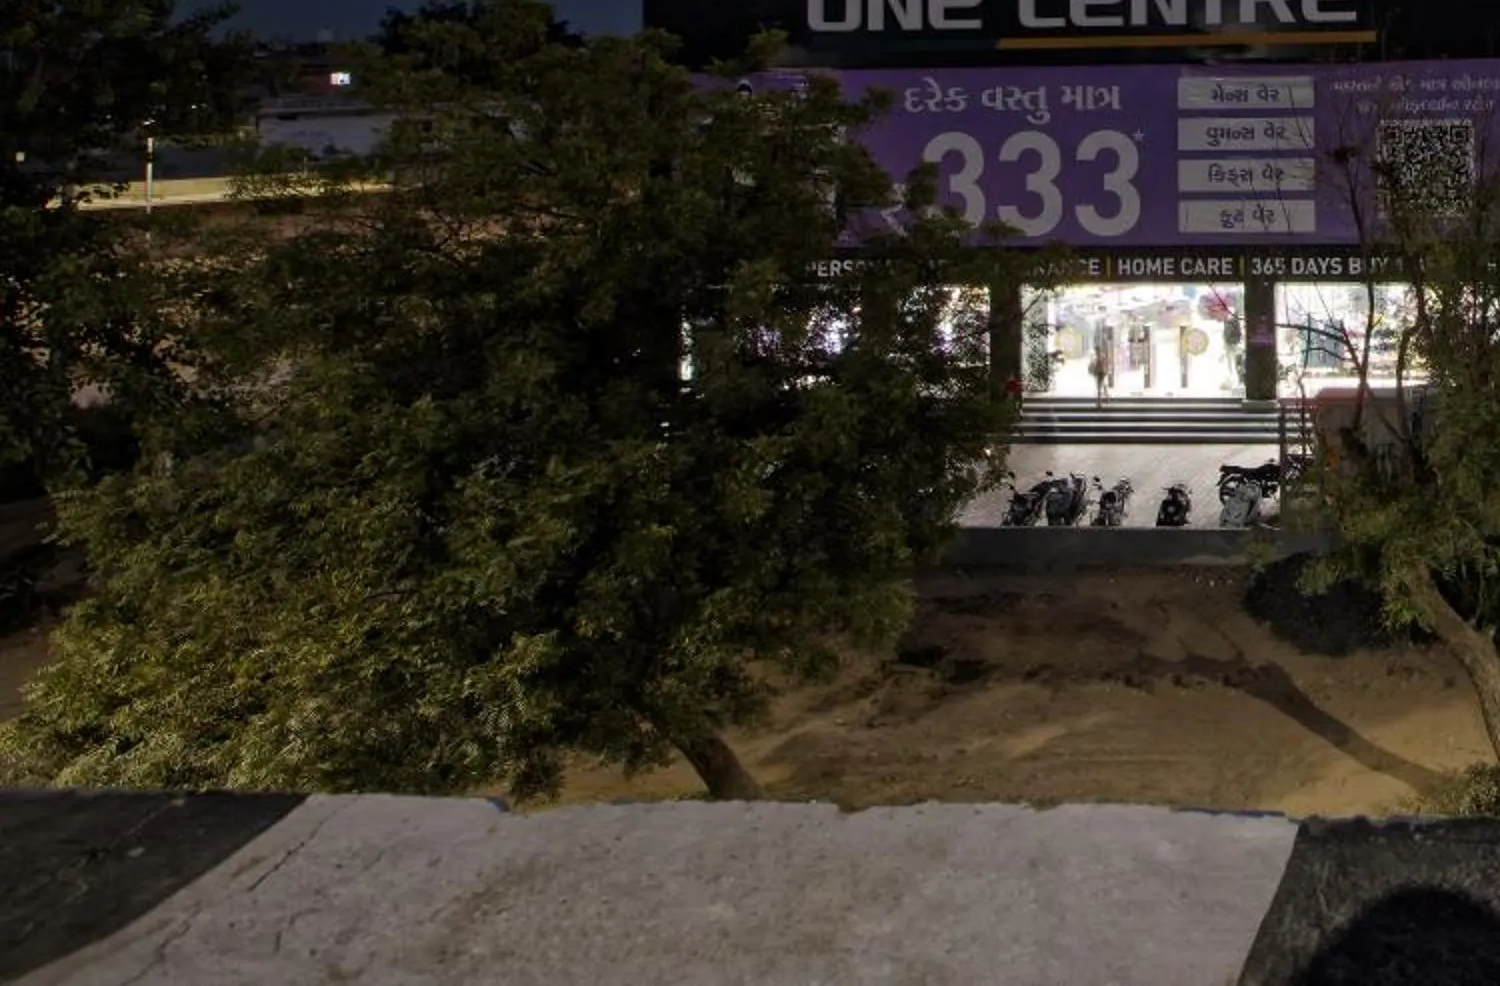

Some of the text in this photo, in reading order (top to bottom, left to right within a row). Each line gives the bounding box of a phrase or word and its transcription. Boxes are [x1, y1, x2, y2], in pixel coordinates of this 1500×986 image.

[903, 76, 1122, 125] દરેક વસ્તુ માત્ર
[1256, 84, 1280, 102] વેર
[1117, 257, 1175, 276] HOME
[1181, 257, 1233, 276] CARE
[1251, 257, 1286, 276] 365
[1292, 257, 1342, 276] DAYS
